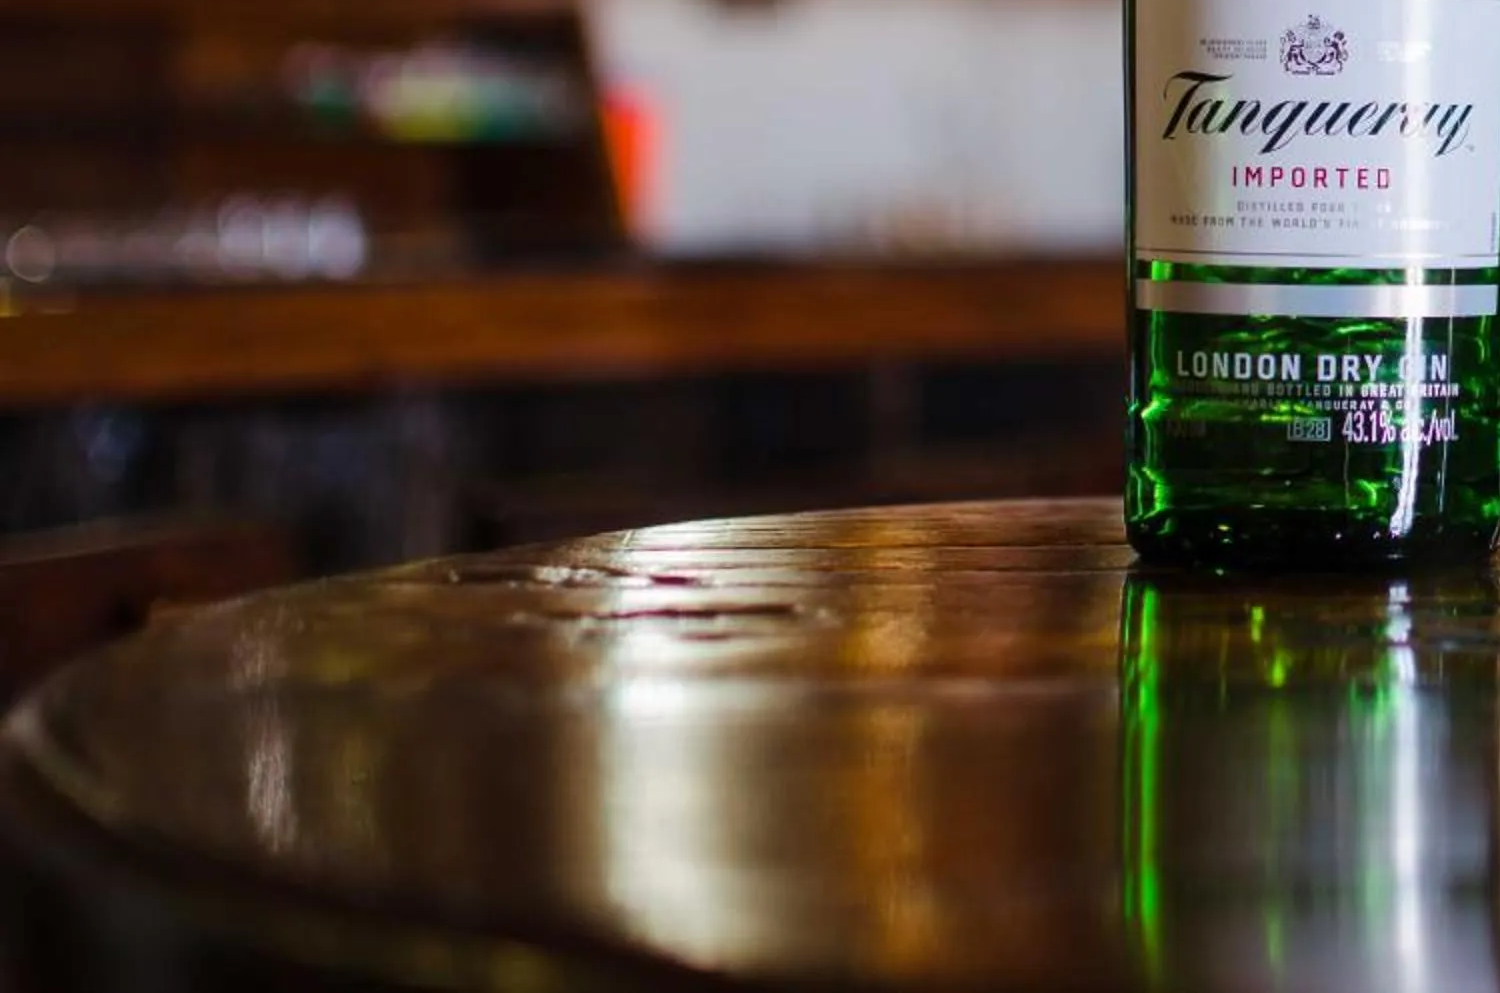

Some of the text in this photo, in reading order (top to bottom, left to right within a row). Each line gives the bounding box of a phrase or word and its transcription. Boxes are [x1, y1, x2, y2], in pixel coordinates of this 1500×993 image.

[1232, 166, 1390, 190] IMPORTED
[1203, 215, 1235, 227] FROM
[1240, 216, 1265, 228] THE
[1177, 350, 1300, 381] LONDON
[1317, 354, 1382, 382] DRY
[1267, 382, 1331, 397] BOTTLED
[1339, 383, 1354, 397] IN
[1361, 382, 1405, 398] GREAT
[1412, 382, 1460, 397] RITAIN
[1342, 409, 1397, 444] 43.1%
